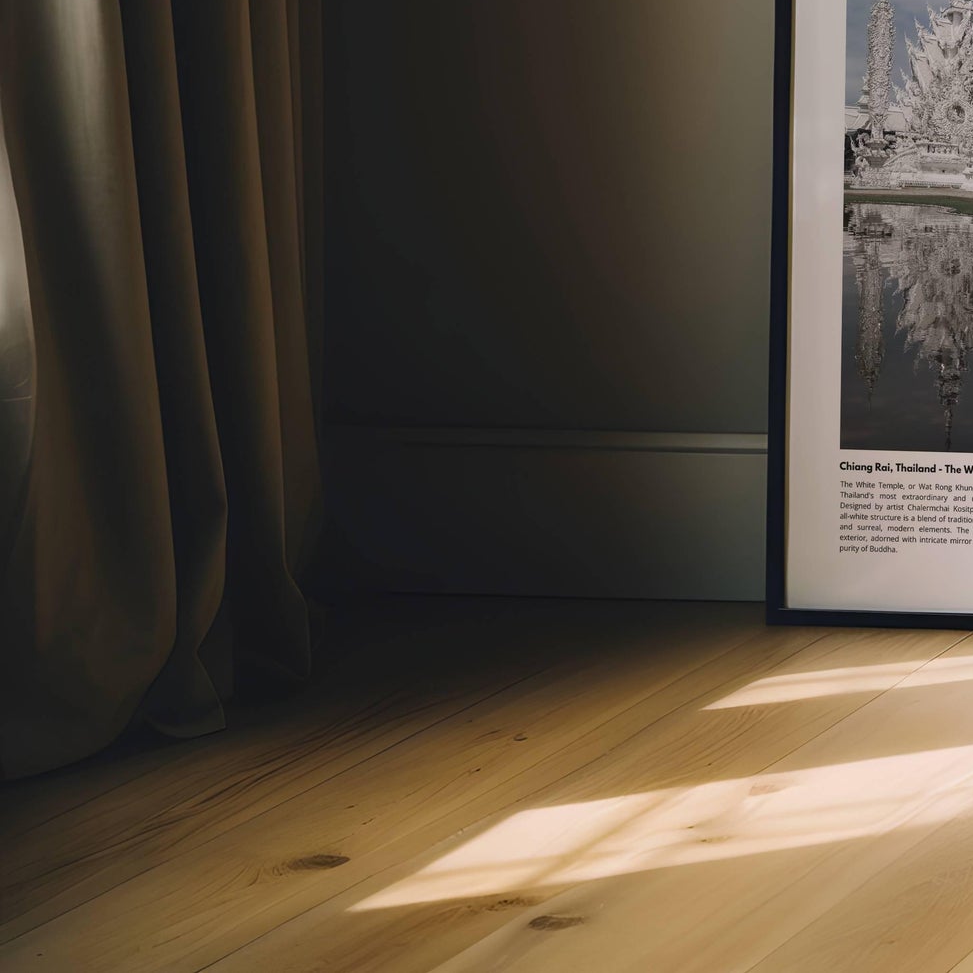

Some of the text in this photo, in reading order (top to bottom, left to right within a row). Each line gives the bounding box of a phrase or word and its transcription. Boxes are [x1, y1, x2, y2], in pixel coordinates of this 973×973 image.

[839, 461, 873, 473] Chiang
[874, 462, 893, 473] Rai,
[895, 462, 936, 473] Thailand
[944, 464, 962, 474] The
[839, 480, 853, 488] The
[855, 481, 876, 489] White
[878, 481, 905, 491] Temple,
[934, 483, 953, 492] Rong
[839, 491, 874, 499] Thailand's
[901, 493, 948, 503] extraordinary
[952, 494, 966, 502] and
[839, 501, 871, 511] Designed
[874, 502, 883, 512] by
[886, 503, 904, 511] artist
[907, 503, 950, 512] Chalermchai
[839, 512, 869, 520] all-white
[902, 514, 909, 522] is
[917, 514, 937, 522] blend
[856, 524, 883, 532] surreal,
[887, 524, 915, 532] modern
[918, 525, 952, 534] elements.
[956, 526, 970, 534] The
[839, 534, 868, 542] exterior,
[870, 534, 899, 542] adorned
[901, 535, 917, 543] with
[919, 535, 948, 544] intricate
[949, 537, 972, 545] mirror
[839, 544, 898, 554] purity of Buddha.
